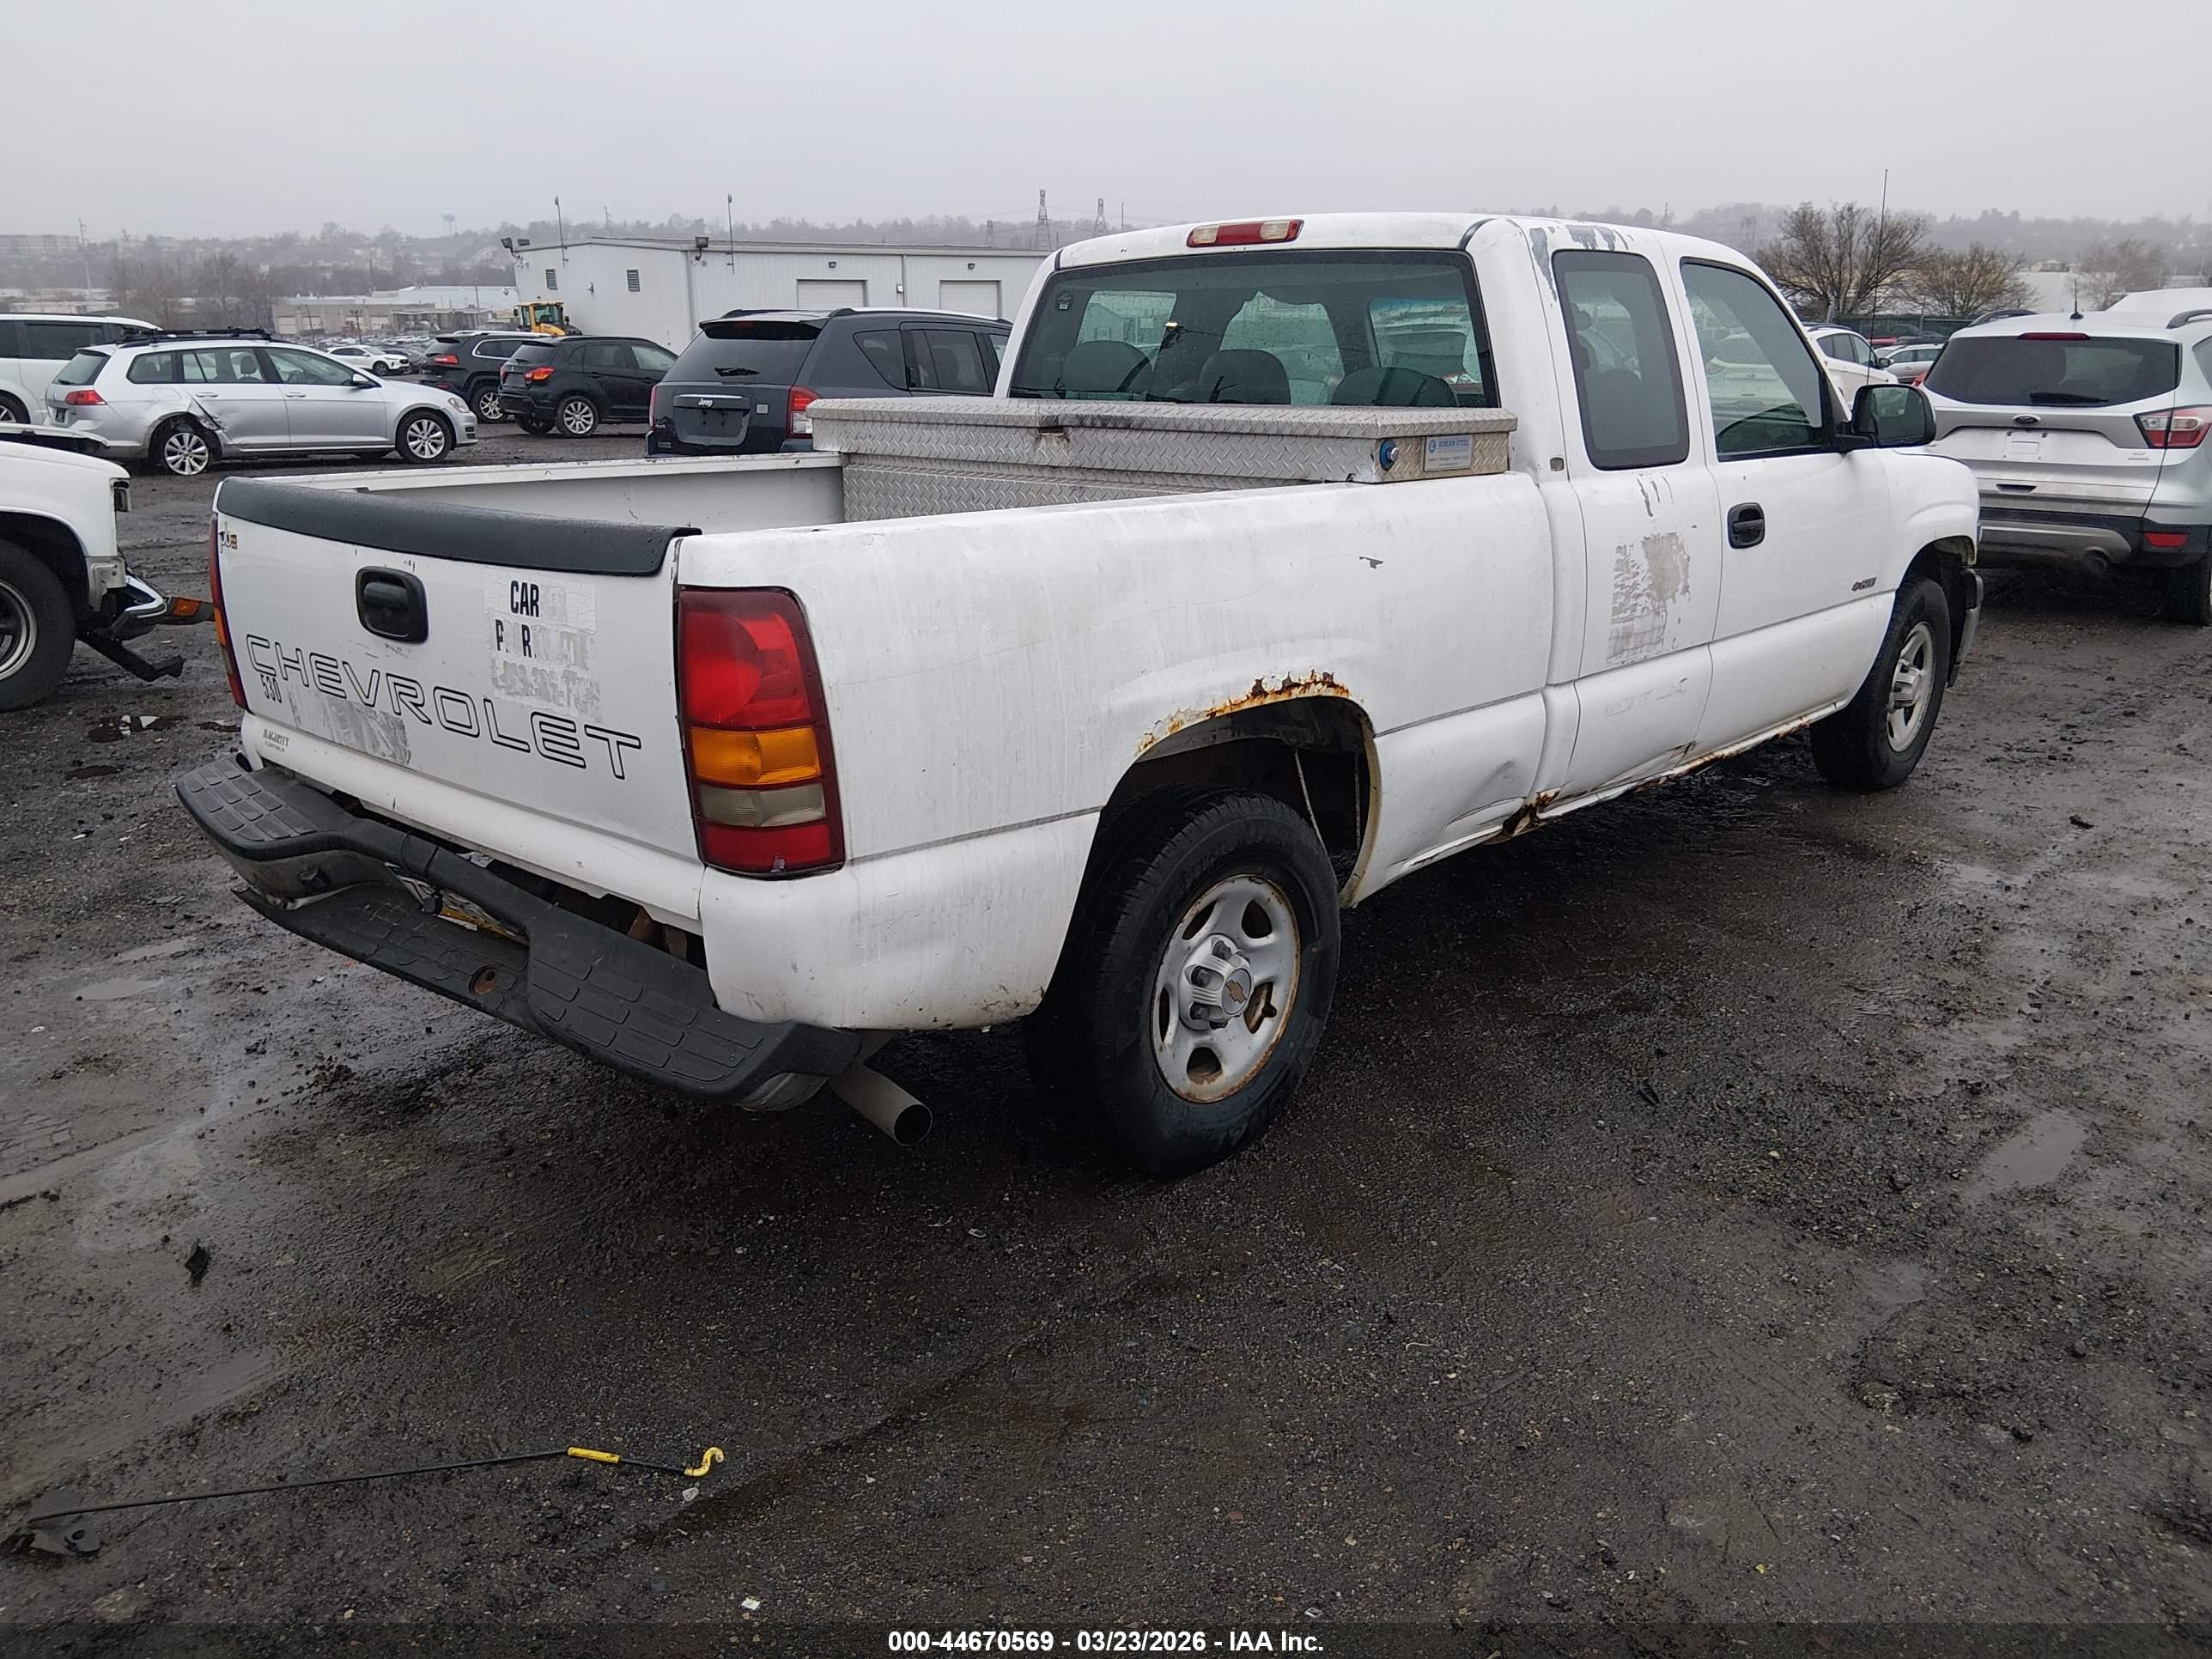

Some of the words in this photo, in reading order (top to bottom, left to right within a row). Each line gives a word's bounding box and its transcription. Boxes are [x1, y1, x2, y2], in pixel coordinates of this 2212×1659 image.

[698, 398, 713, 407] Jeep
[510, 580, 540, 618] CAR
[260, 673, 283, 703] 530
[246, 634, 642, 780] CHEVROLET
